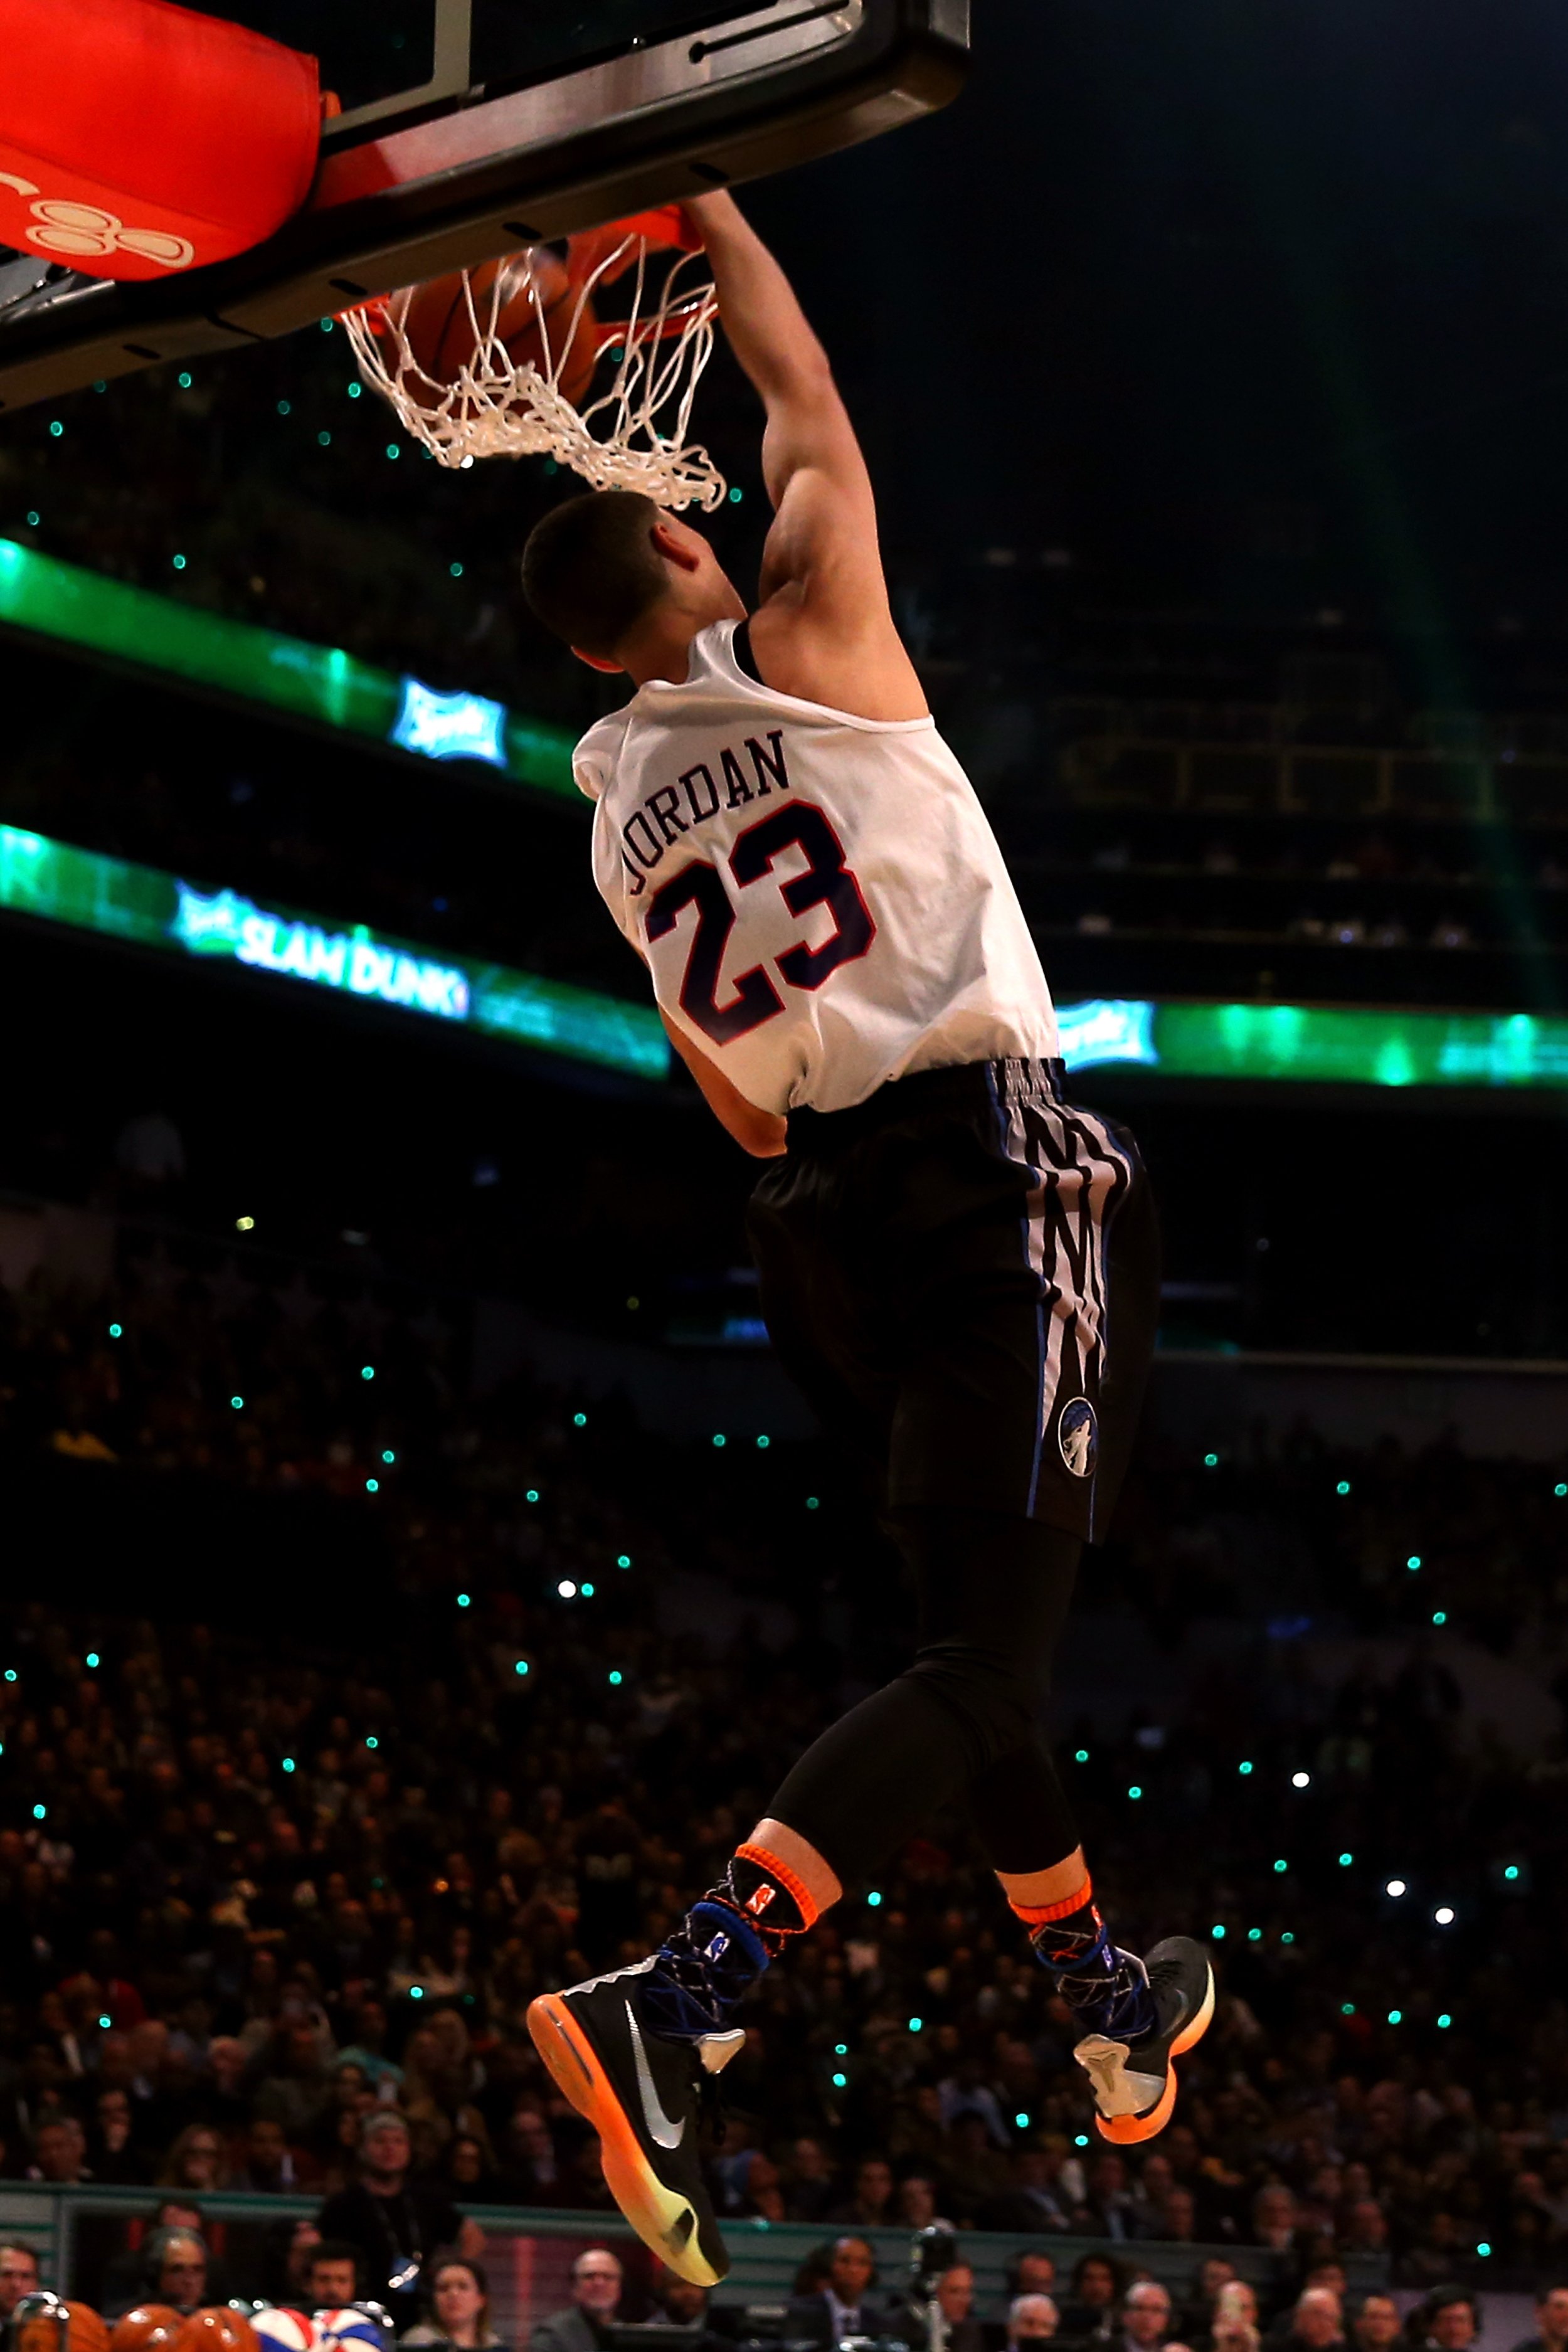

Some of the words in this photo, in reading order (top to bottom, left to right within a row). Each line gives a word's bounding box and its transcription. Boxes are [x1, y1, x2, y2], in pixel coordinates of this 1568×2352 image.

[620, 729, 790, 896] JORDAN
[236, 914, 347, 987] SLAM
[644, 798, 877, 1047] 23
